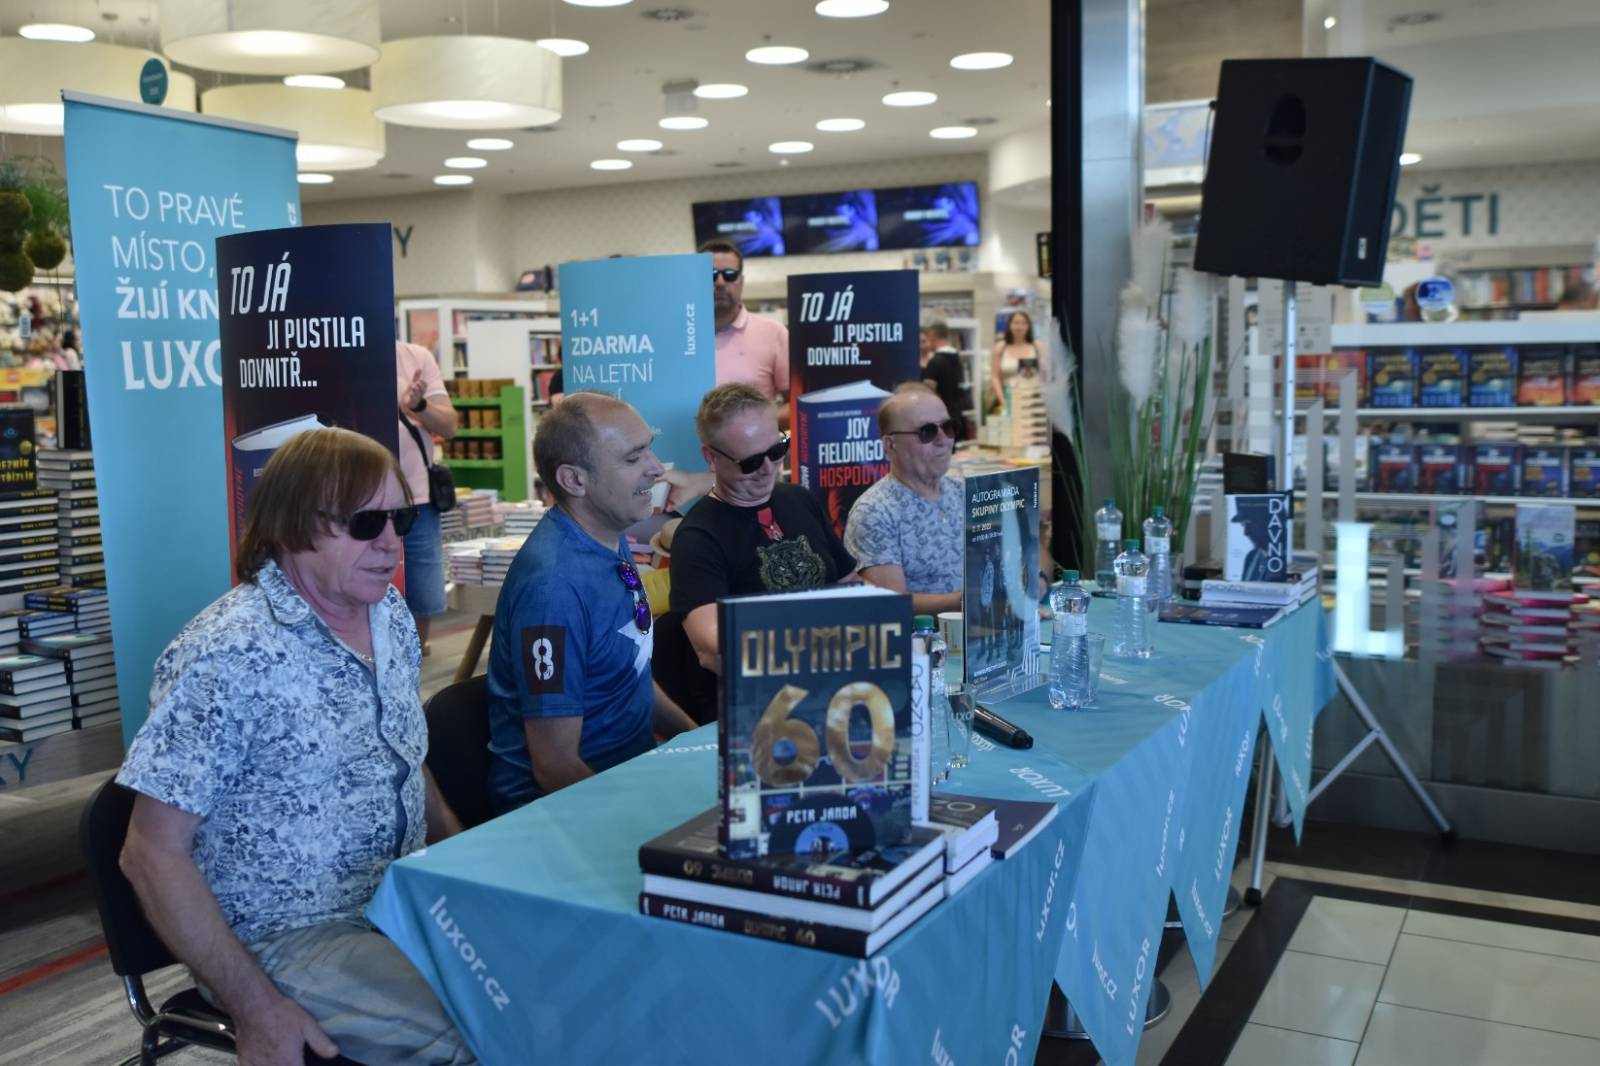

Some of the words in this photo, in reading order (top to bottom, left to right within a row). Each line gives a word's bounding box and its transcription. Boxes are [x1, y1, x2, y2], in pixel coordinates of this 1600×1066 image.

[103, 184, 149, 220] TO
[158, 191, 246, 228] PRAVÉ
[111, 230, 215, 278] MÍSTO,
[115, 276, 169, 320] ŽIJÍ
[177, 288, 219, 320] KN
[230, 265, 255, 315] TO
[258, 251, 292, 313] JÁ
[570, 308, 599, 328] 1+1
[800, 292, 824, 323] TO
[826, 284, 854, 322] JÁ
[266, 319, 279, 349] JI
[285, 316, 365, 349] PUSTILA
[571, 333, 655, 356] ZDARMA
[684, 303, 696, 356] luxor.cz
[833, 326, 844, 343] JI
[847, 323, 903, 343] PUSTILA
[239, 351, 318, 388] DOVNITŘ...
[572, 365, 596, 384] NA
[600, 359, 654, 384] LETNÍ
[807, 342, 872, 366] DOVNITŘ...
[845, 416, 871, 440] JOY
[818, 439, 885, 465] FIELDINGO
[819, 463, 890, 488] HOSPODYN
[971, 504, 999, 518] SKUPINY
[1267, 498, 1283, 573] DAVNO
[531, 637, 555, 681] 8
[741, 623, 903, 677] OLYMPIC
[752, 680, 897, 788] 60
[786, 810, 816, 824] PETR
[819, 806, 858, 821] JANDA
[663, 903, 688, 921] PETR
[691, 909, 725, 929] JANDA
[429, 894, 511, 1012] luxor.cz
[814, 955, 901, 1029] LUXOR
[1126, 937, 1150, 1036] LUXOR
[1004, 1023, 1027, 1066] OR
